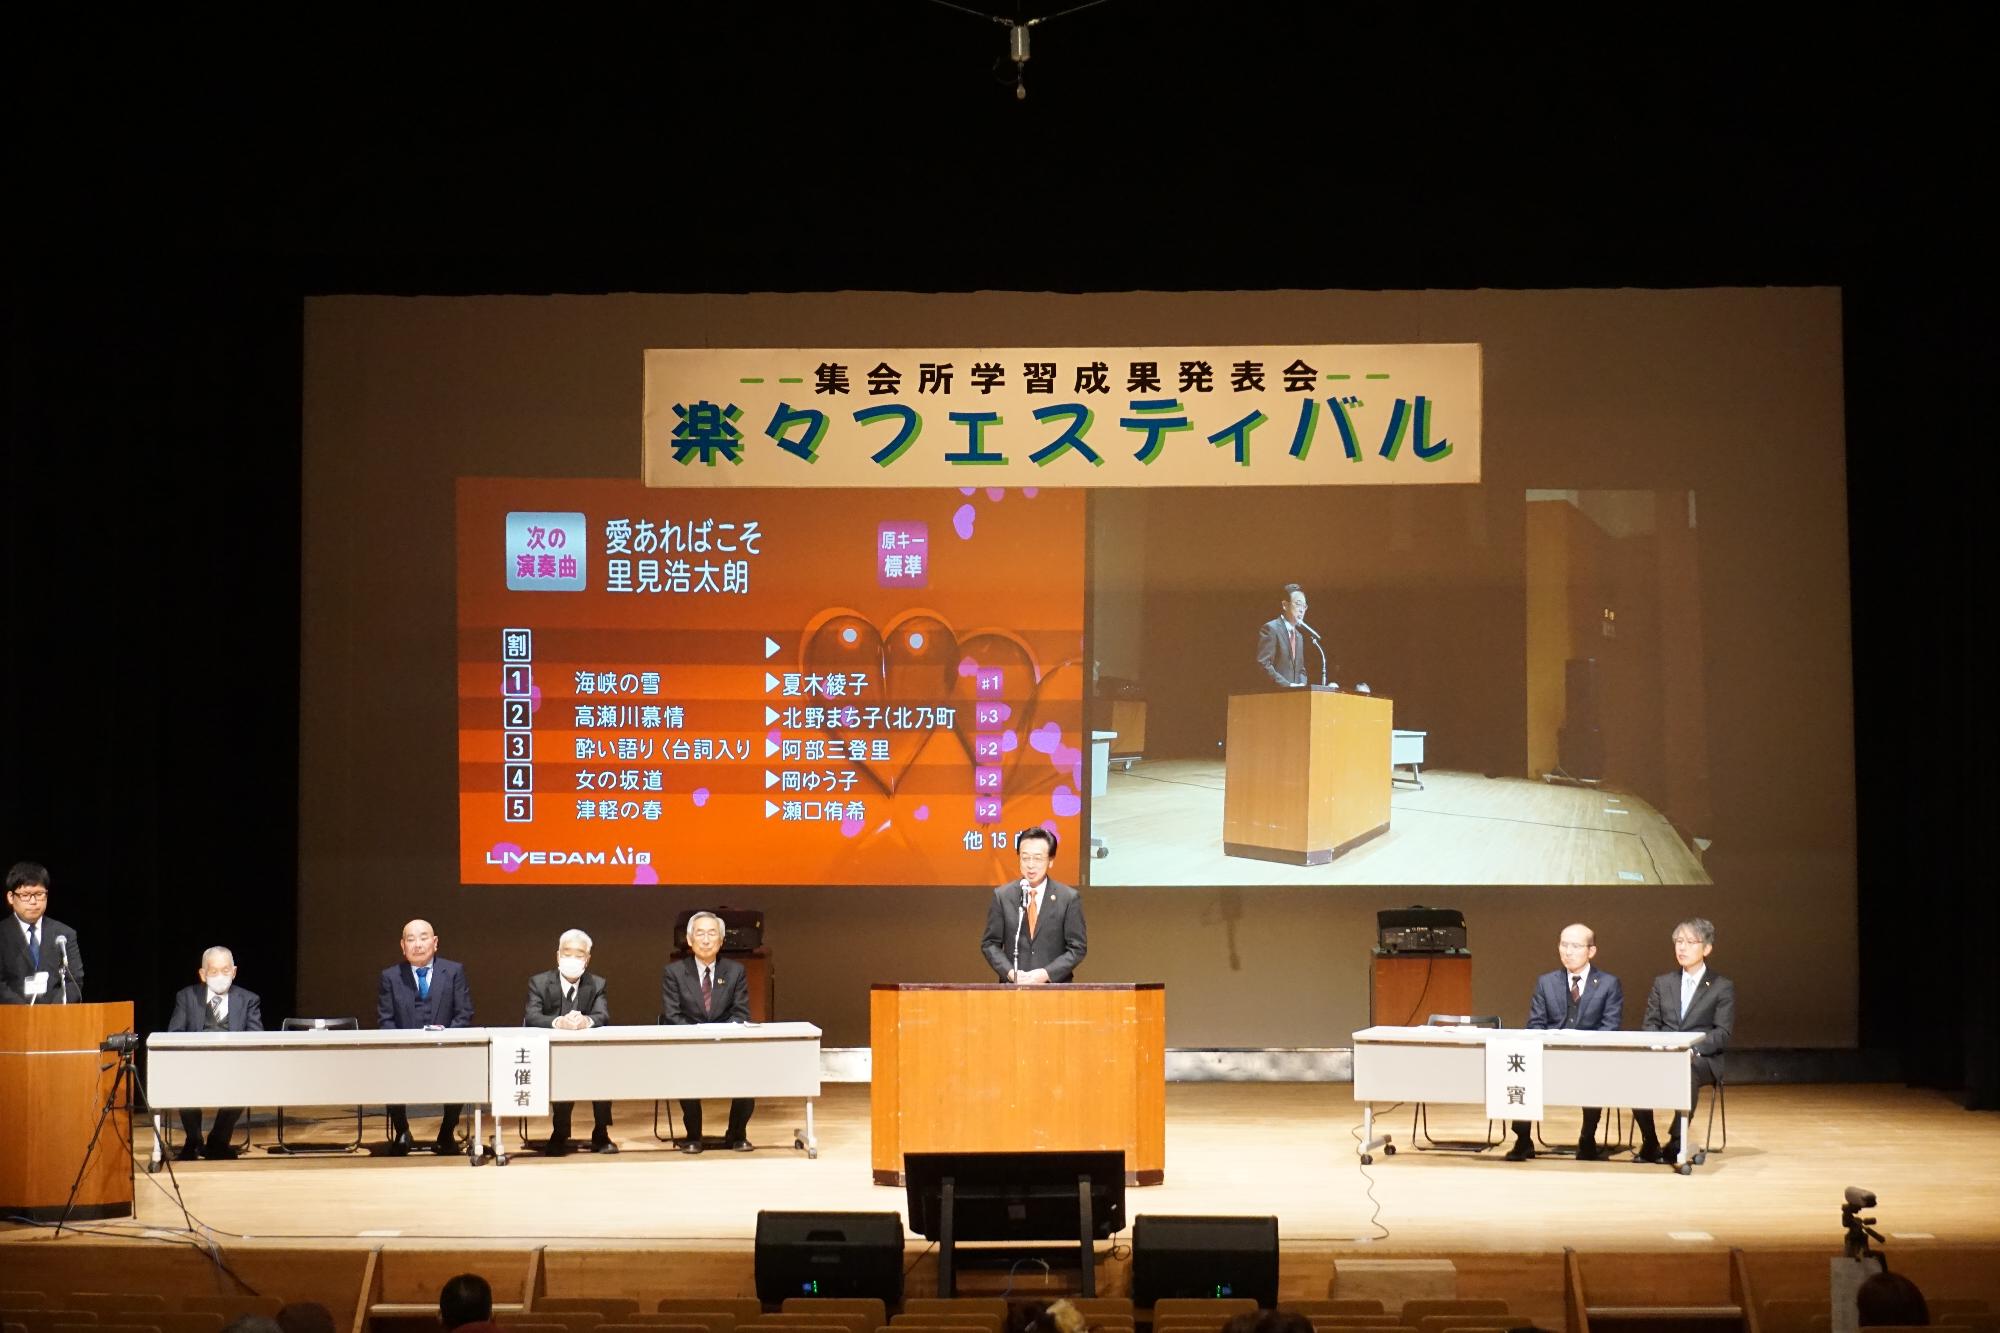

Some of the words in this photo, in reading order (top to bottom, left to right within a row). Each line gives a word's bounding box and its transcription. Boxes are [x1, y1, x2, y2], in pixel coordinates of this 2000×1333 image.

[814, 359, 1318, 395] 集会所学習成果発表会
[527, 525, 566, 549] 次の
[605, 518, 762, 555] 愛あればこそ
[881, 531, 925, 550] 原キー
[516, 554, 577, 579] 演奏曲
[606, 559, 748, 594] 里見浩太朗
[884, 554, 922, 578] 標準
[507, 634, 527, 657] 割
[511, 670, 521, 691] 1
[574, 671, 661, 695] 海峡の雪
[782, 673, 869, 697] 夏木綾子
[511, 704, 523, 724] 2
[574, 705, 685, 729] 高瀬川慕情
[512, 737, 524, 756] 3
[782, 740, 890, 761] 阿部三登里
[512, 769, 525, 788] 4
[575, 769, 663, 791] 女の坂道
[782, 770, 858, 792] 岡ゆう子
[512, 800, 525, 818] 5
[575, 800, 663, 821] 津軽の春
[963, 830, 983, 850] 他
[991, 831, 1007, 849] 15
[513, 1047, 532, 1107] 主催者
[1506, 1053, 1526, 1106] 来賓
